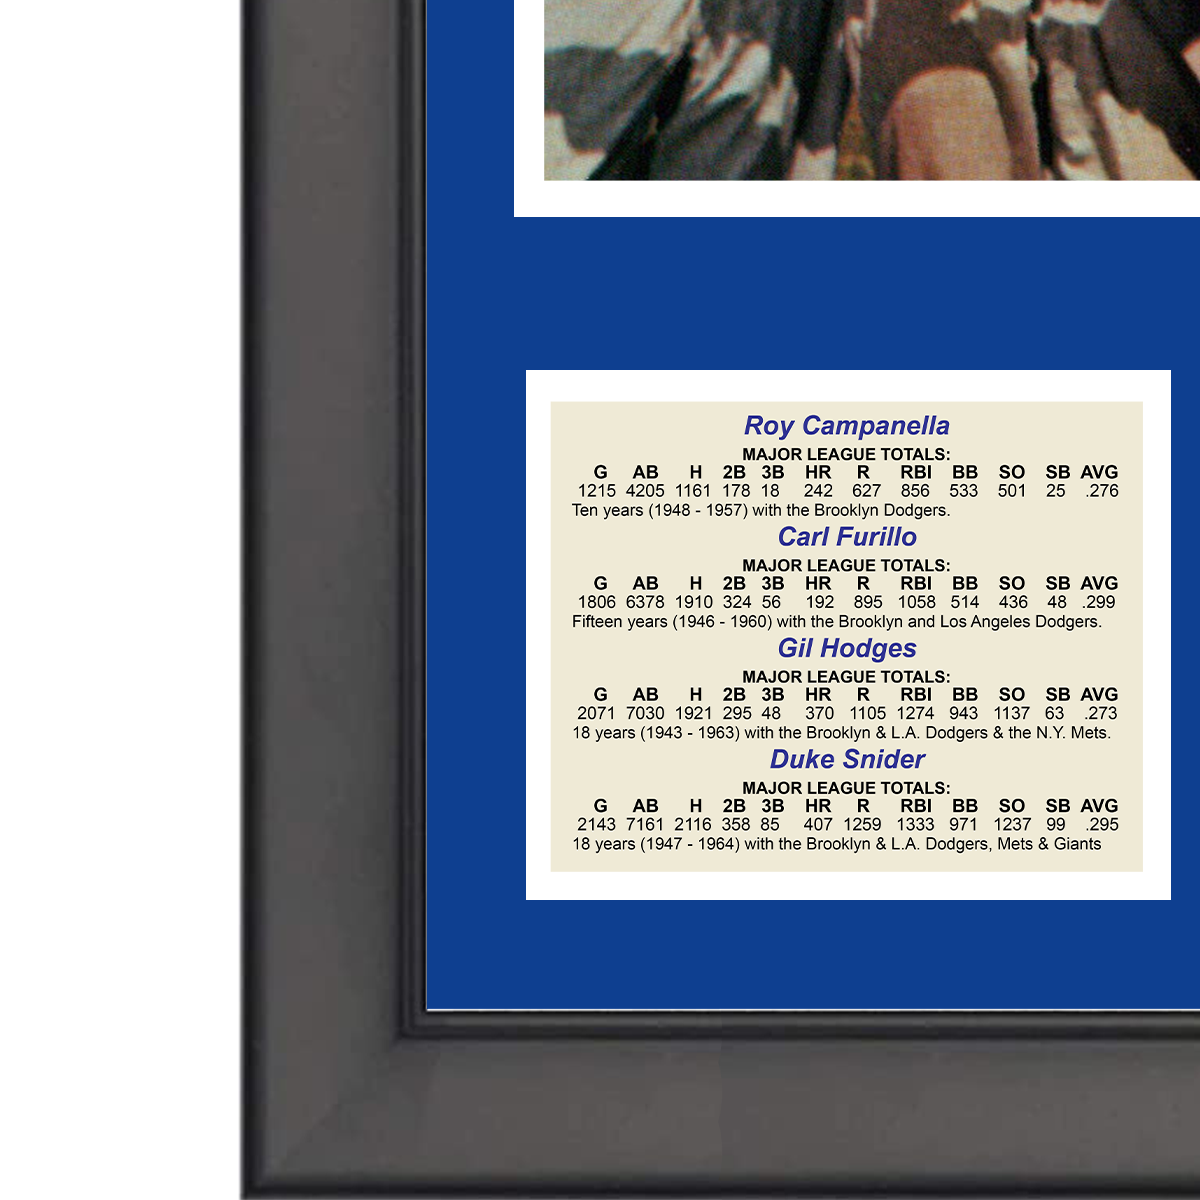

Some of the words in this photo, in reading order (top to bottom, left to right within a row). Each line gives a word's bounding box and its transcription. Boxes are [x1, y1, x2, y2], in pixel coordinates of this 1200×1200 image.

[743, 414, 796, 441] Roy
[802, 414, 950, 441] Campanella
[742, 447, 803, 461] MAJOR
[807, 447, 876, 461] LEAGUE
[880, 447, 951, 461] TOTALS:
[593, 464, 608, 480] G
[632, 464, 659, 480] AB
[690, 464, 702, 480] H
[722, 464, 747, 480] 2B
[761, 464, 785, 480] 3B
[805, 464, 832, 480] HR
[857, 464, 871, 480] R
[900, 464, 932, 480] RBI
[952, 464, 979, 480] BB
[998, 464, 1026, 480] SO
[1045, 464, 1071, 480] SB
[1079, 464, 1119, 480] AVG
[578, 483, 617, 498] 1215
[625, 483, 665, 498] 4205
[675, 483, 710, 498] 1161
[722, 483, 751, 498] 178
[761, 483, 780, 498] 18
[803, 483, 833, 498] 242
[852, 483, 882, 498] 627
[900, 483, 930, 498] 856
[949, 483, 979, 498] 533
[997, 483, 1025, 498] 501
[1046, 483, 1066, 498] 25
[1085, 483, 1119, 498] .276
[571, 502, 598, 517] Ten
[602, 505, 644, 520] years
[648, 502, 691, 520] (1948
[706, 502, 748, 520] 1957)
[751, 502, 782, 517] with
[786, 503, 810, 517] the
[814, 502, 879, 520] Brooklyn
[884, 502, 951, 520] Dodgers.
[778, 525, 831, 547] Carl
[835, 525, 918, 547] Furillo
[742, 558, 803, 573] MAJOR
[807, 558, 876, 573] LEAGUE
[880, 558, 951, 573] TOTALS:
[578, 594, 617, 609] 1806
[625, 594, 665, 609] 6378
[675, 594, 714, 609] 1910
[722, 594, 752, 609] 324
[761, 594, 781, 609] 56
[806, 594, 835, 609] 192
[853, 594, 883, 609] 895
[898, 594, 937, 609] 1058
[950, 594, 980, 609] 514
[998, 594, 1029, 609] 436
[1047, 594, 1067, 609] 48
[1082, 594, 1116, 609] .299
[572, 614, 623, 629] Fifteen
[627, 617, 668, 632] years
[672, 614, 715, 632] (1946
[730, 614, 773, 632] 1960)
[776, 614, 806, 629] with
[810, 614, 835, 629] the
[839, 614, 903, 632] Brooklyn
[907, 614, 935, 629] and
[940, 614, 968, 629] Los
[970, 614, 1031, 632] Angeles
[1035, 614, 1102, 632] Dodgers.
[778, 636, 814, 658] Gil
[819, 637, 918, 664] Hodges
[742, 669, 803, 684] MAJOR
[807, 669, 876, 684] LEAGUE
[880, 669, 951, 684] TOTALS:
[577, 705, 614, 720] 2071
[626, 705, 665, 720] 7030
[675, 705, 711, 720] 1921
[722, 705, 753, 720] 295
[761, 705, 782, 720] 48
[805, 705, 835, 720] 370
[850, 705, 887, 720] 1105
[897, 705, 935, 720] 1274
[949, 705, 979, 720] 943
[994, 705, 1031, 720] 1137
[1044, 705, 1065, 720] 63
[1084, 705, 1118, 720] .273
[573, 725, 591, 740] 18
[594, 728, 636, 743] years
[640, 725, 683, 743] (1943
[698, 725, 740, 743] 1963)
[744, 725, 774, 740] with
[778, 725, 802, 740] the
[806, 725, 871, 743] Brooklyn
[875, 725, 887, 740] &
[891, 725, 920, 739] L.A.
[926, 725, 989, 743] Dodgers
[992, 725, 1004, 740] &
[1007, 725, 1032, 740] the
[1036, 725, 1066, 739] N.Y.
[1071, 725, 1111, 740] Mets.
[769, 748, 835, 770] Duke
[842, 748, 927, 770] Snider
[742, 780, 803, 795] MAJOR
[807, 780, 876, 795] LEAGUE
[880, 780, 951, 795] TOTALS:
[593, 798, 608, 814] G
[632, 798, 659, 813] AB
[690, 798, 702, 813] H
[722, 798, 747, 813] 2B
[761, 798, 785, 814] 3B
[805, 798, 832, 813] HR
[857, 798, 871, 813] R
[900, 798, 932, 813] RBI
[952, 798, 979, 813] BB
[998, 798, 1026, 814] SO
[1045, 798, 1071, 814] SB
[1079, 798, 1119, 814] AVG
[577, 816, 617, 832] 2143
[626, 816, 663, 832] 7161
[674, 816, 712, 832] 2116
[721, 816, 751, 832] 358
[760, 816, 780, 832] 85
[803, 816, 834, 832] 407
[844, 816, 882, 832] 1259
[897, 816, 935, 832] 1333
[949, 816, 976, 832] 971
[994, 816, 1032, 832] 1237
[1046, 816, 1066, 832] 99
[1085, 816, 1119, 832] .295
[573, 836, 591, 851] 18
[594, 839, 636, 854] years
[640, 836, 683, 854] (1947
[698, 836, 740, 854] 1964)
[744, 836, 774, 851] with
[778, 836, 802, 851] the
[806, 836, 871, 854] Brooklyn
[875, 836, 887, 851] &
[891, 836, 920, 851] L.A.
[926, 836, 993, 854] Dodgers,
[997, 836, 1034, 851] Mets
[1038, 836, 1050, 851] &
[1053, 836, 1102, 851] Giants
